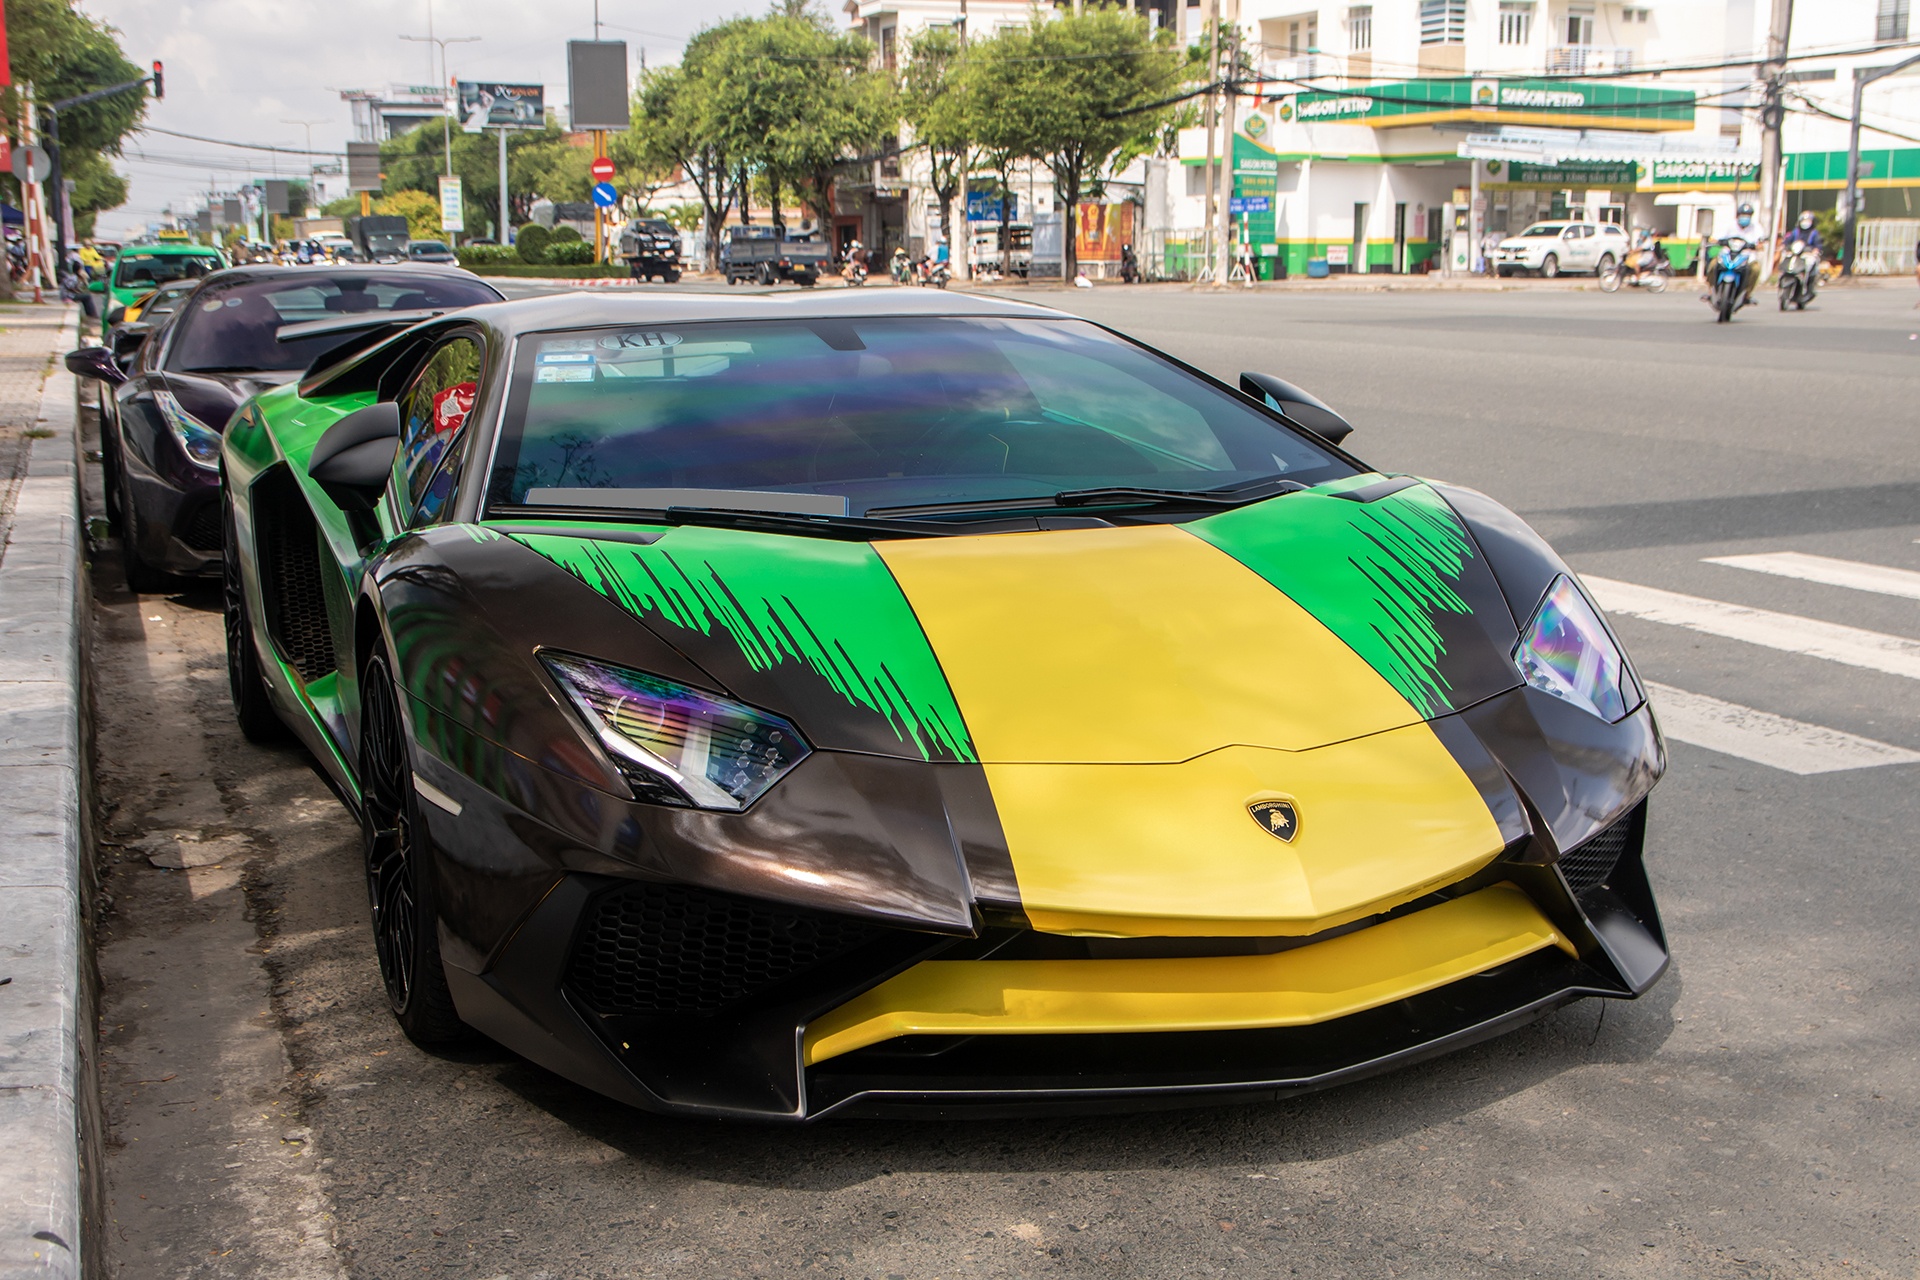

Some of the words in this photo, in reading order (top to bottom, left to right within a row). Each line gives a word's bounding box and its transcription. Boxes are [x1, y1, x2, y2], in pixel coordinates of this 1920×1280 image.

[1501, 87, 1546, 106] SAIGON
[1546, 90, 1585, 107] PETRO
[1338, 97, 1373, 114] PETRO
[1655, 162, 1706, 178] SAIGON
[616, 333, 669, 349] KH
[1251, 803, 1290, 812] LAMBORGHINI
